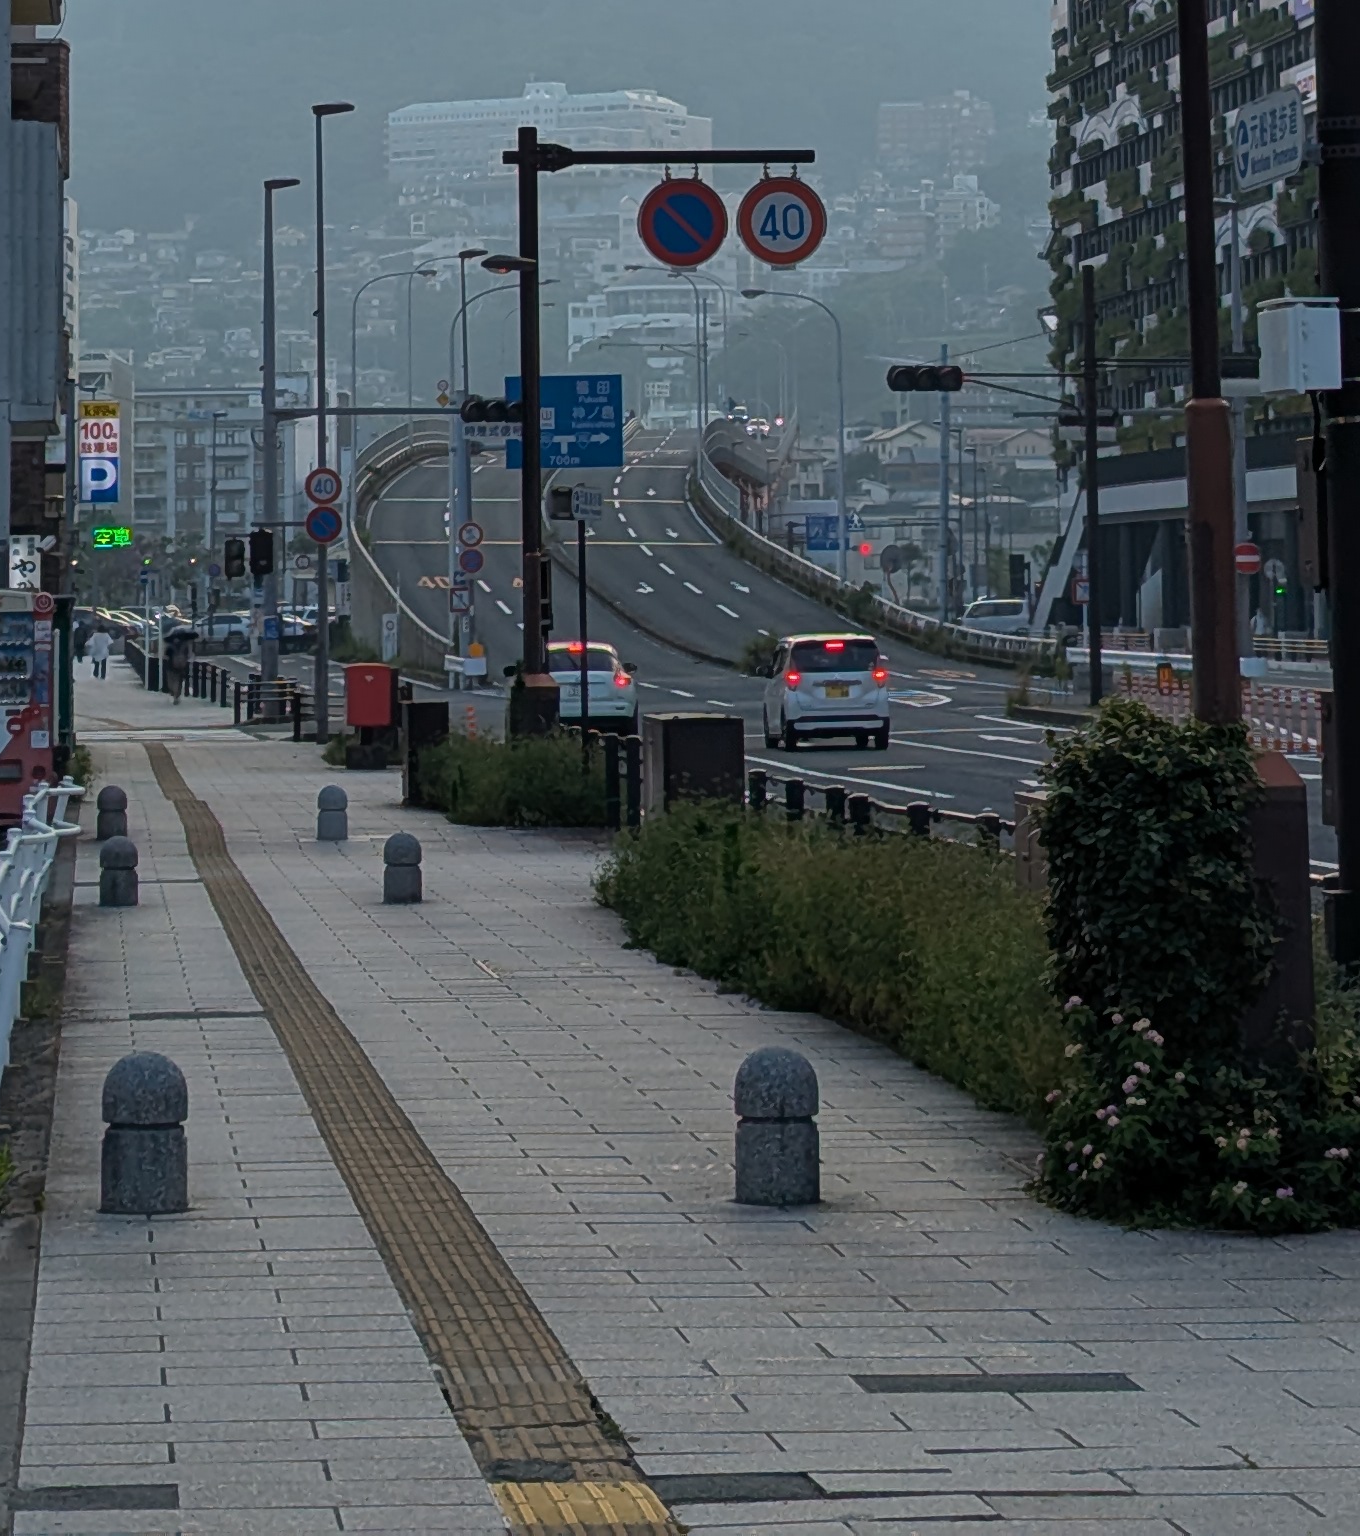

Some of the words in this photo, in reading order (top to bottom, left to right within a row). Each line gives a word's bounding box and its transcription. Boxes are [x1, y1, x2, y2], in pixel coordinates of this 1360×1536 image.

[759, 203, 805, 241] 40
[81, 458, 117, 502] P
[313, 477, 335, 495] 40
